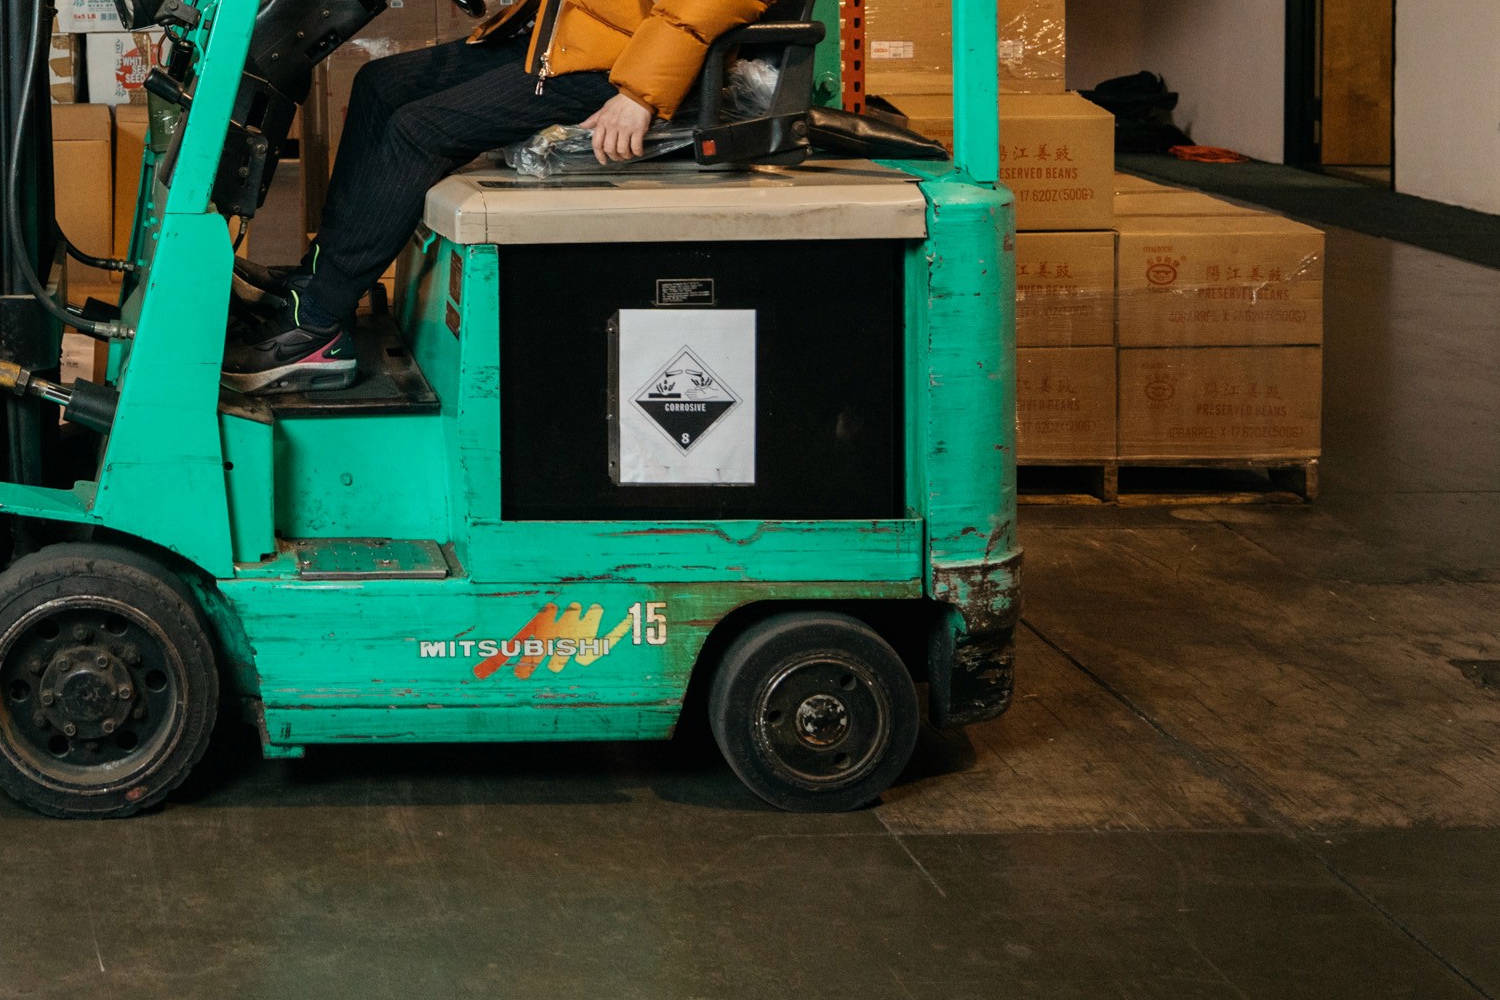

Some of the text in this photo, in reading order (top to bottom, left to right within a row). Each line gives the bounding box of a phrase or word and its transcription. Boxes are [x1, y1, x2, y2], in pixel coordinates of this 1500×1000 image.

[125, 74, 146, 83] SEED
[998, 168, 1078, 180] ESERVED BEANS
[1257, 288, 1289, 300] BEANS
[664, 402, 706, 412] CORROSIVE
[681, 433, 690, 444] 8
[420, 602, 668, 658] MITSUBISHI 15
